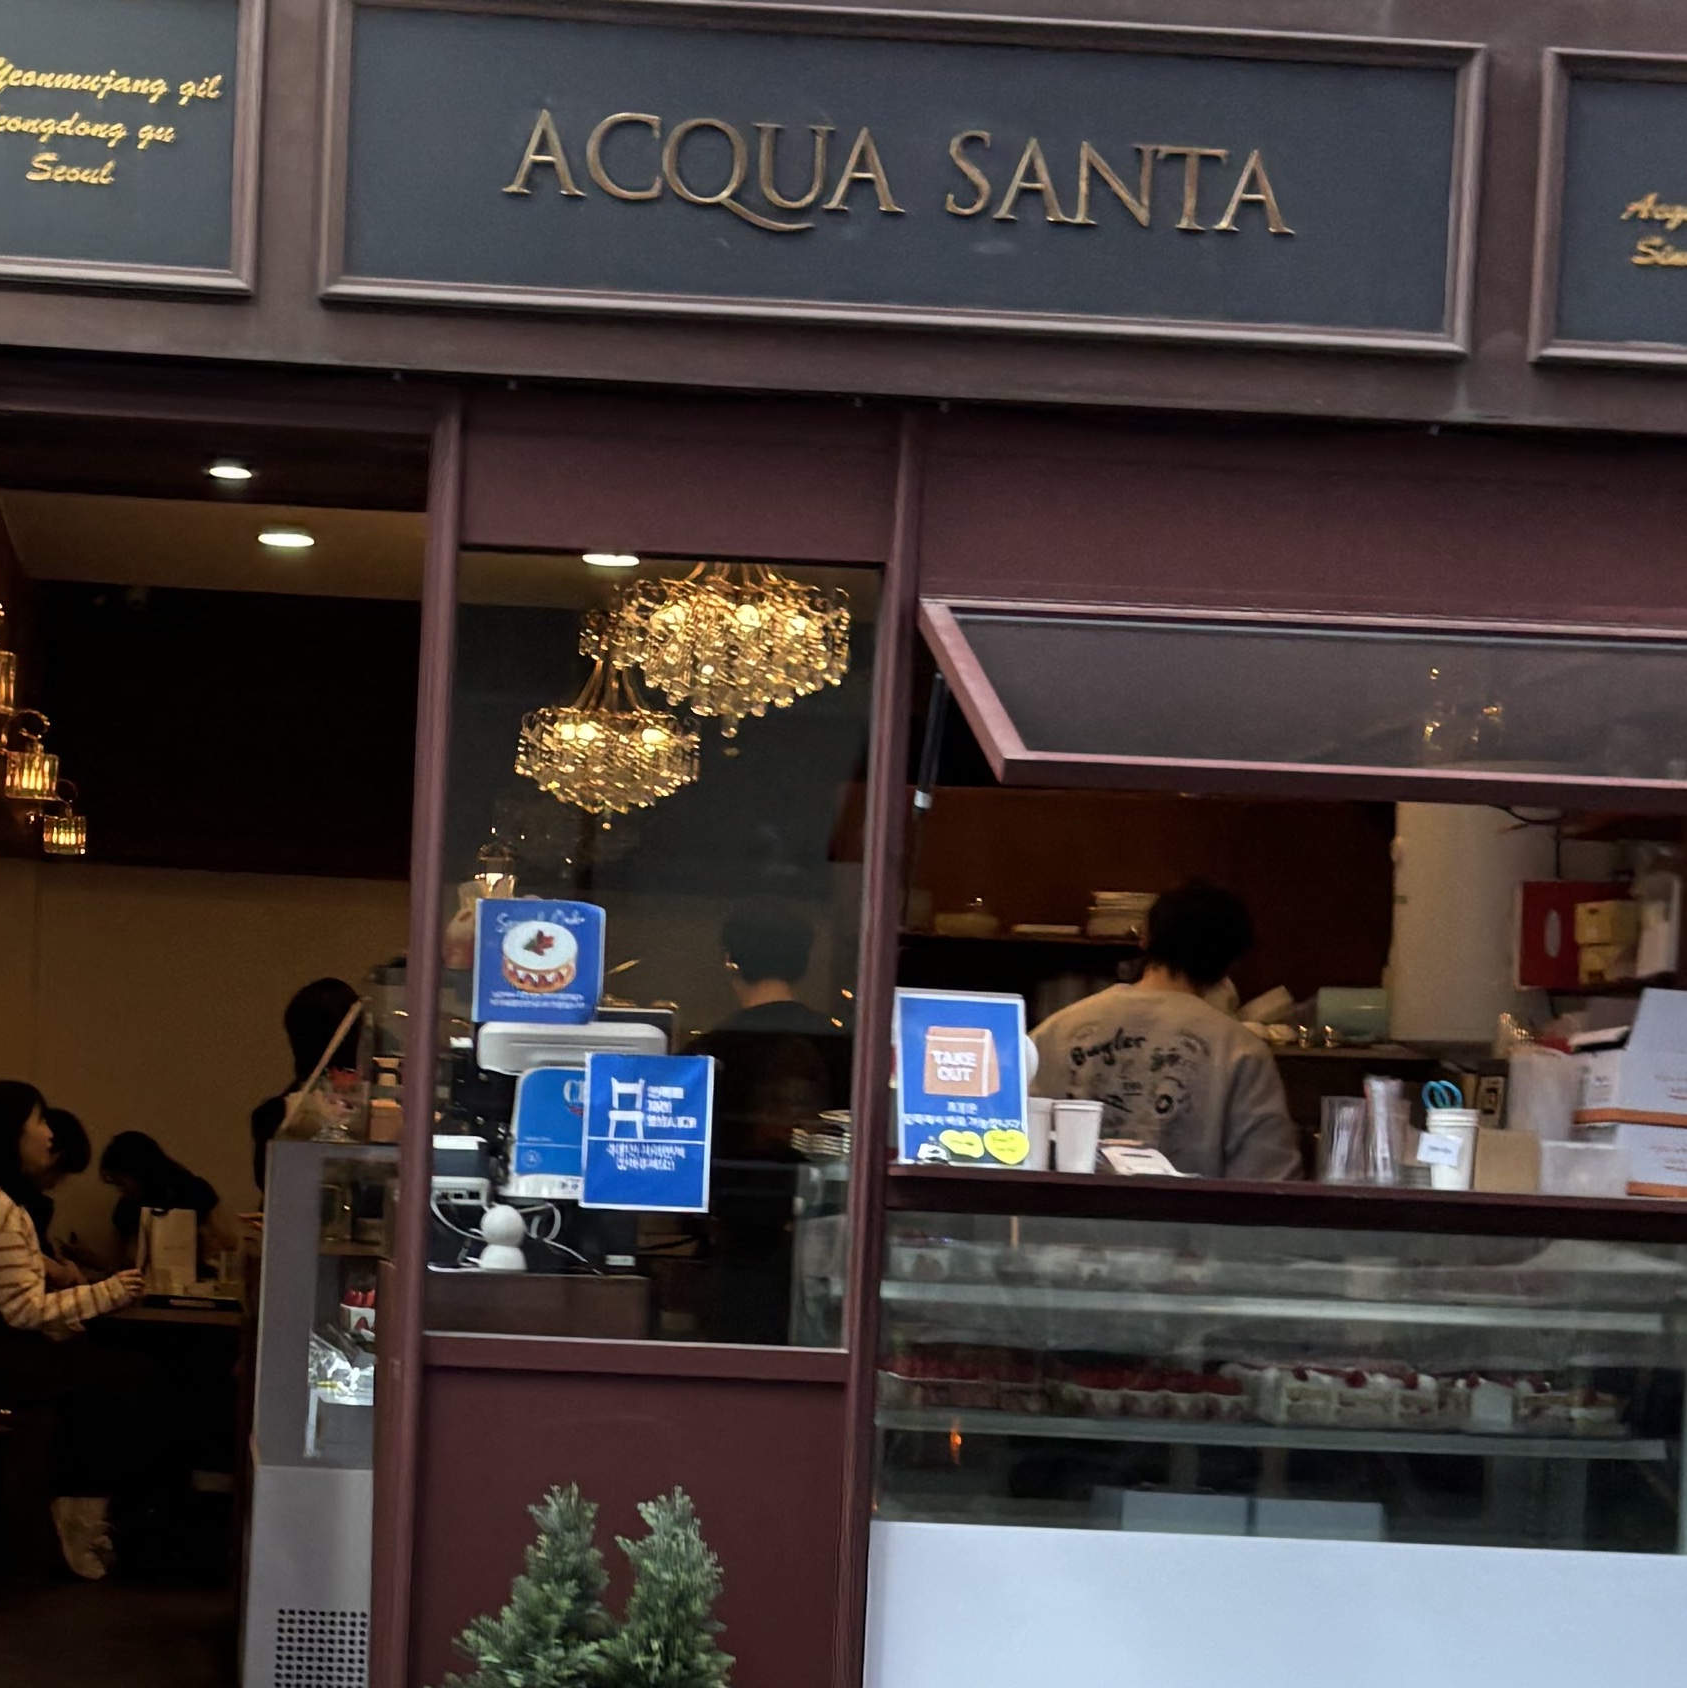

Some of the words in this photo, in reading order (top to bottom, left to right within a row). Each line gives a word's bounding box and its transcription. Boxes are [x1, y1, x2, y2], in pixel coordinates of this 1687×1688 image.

[178, 73, 224, 106] gil
[137, 124, 177, 150] gu
[25, 151, 117, 186] Seoul
[501, 108, 906, 233] ACQUA
[944, 129, 1296, 236] SANTA
[931, 1050, 977, 1067] TAKE
[936, 1067, 973, 1081] OUT
